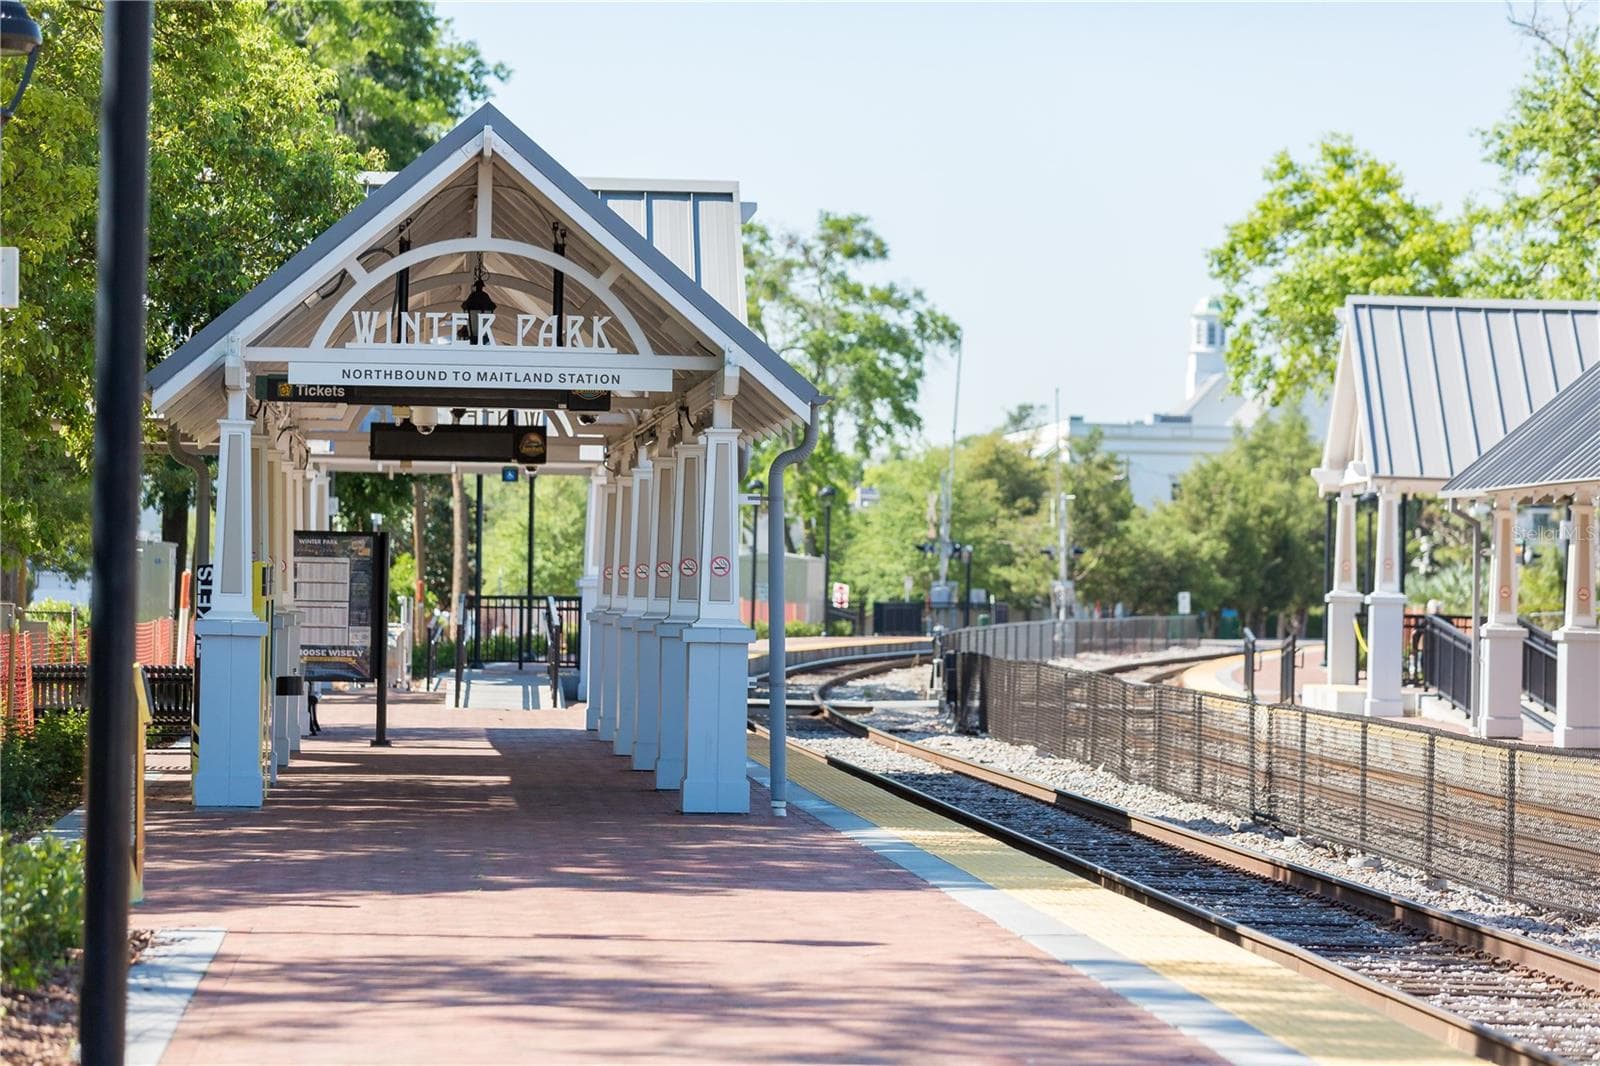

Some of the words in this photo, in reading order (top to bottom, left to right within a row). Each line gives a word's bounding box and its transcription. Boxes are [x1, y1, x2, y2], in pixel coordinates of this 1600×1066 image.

[352, 310, 497, 346] WINTER
[517, 314, 612, 349] PARK
[341, 368, 448, 381] NORTHBOUND
[453, 370, 472, 383] TO
[476, 371, 554, 384] MAITLAND
[558, 373, 621, 385] STATION
[296, 383, 346, 397] Tickets
[322, 538, 338, 546] PARK
[299, 648, 327, 657] OOSE
[328, 648, 364, 657] WISELY
